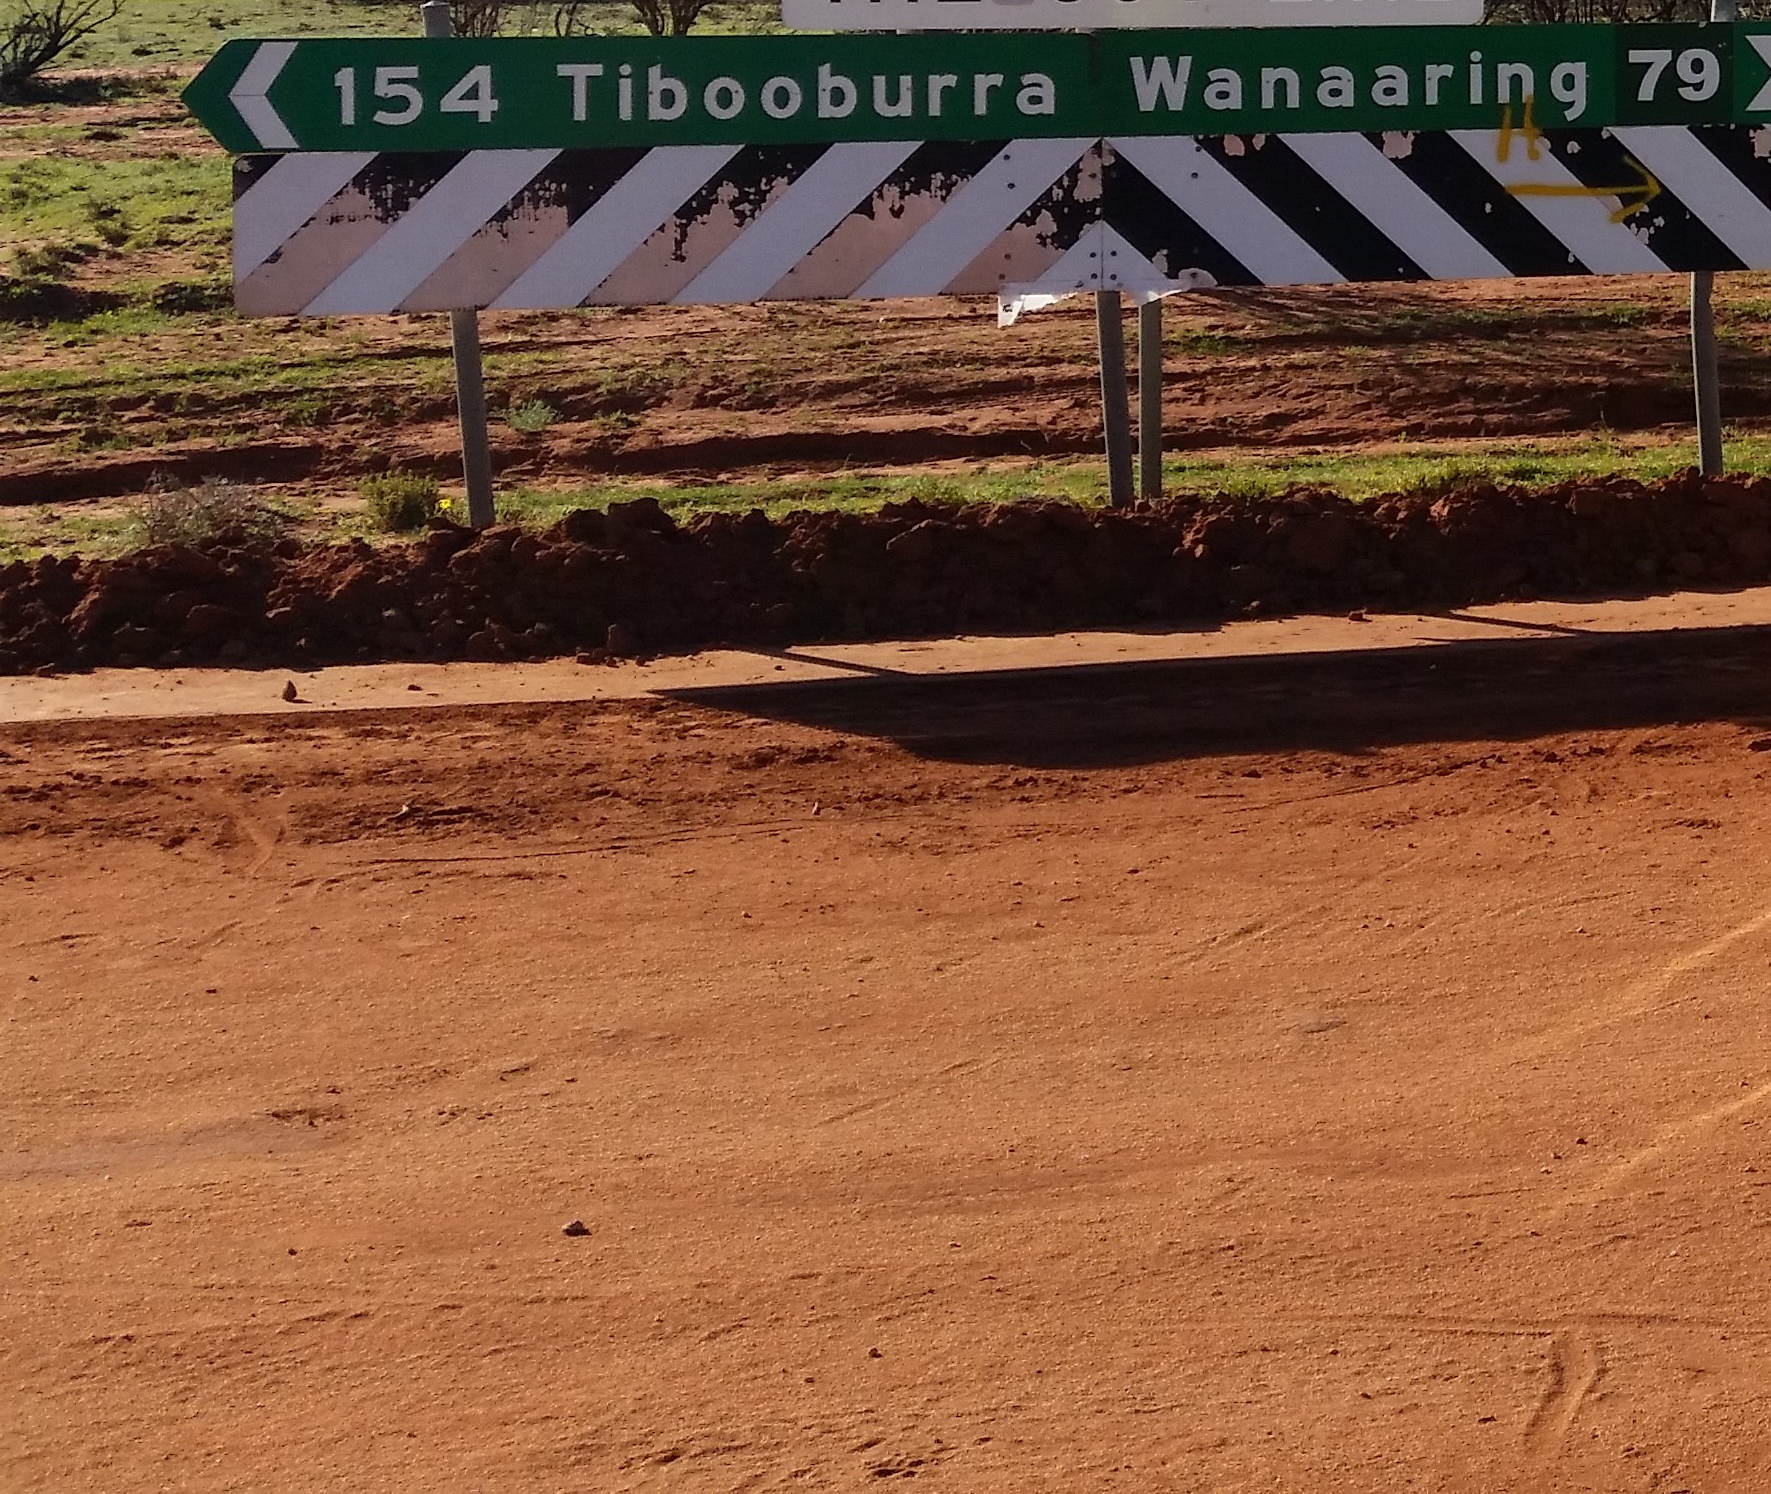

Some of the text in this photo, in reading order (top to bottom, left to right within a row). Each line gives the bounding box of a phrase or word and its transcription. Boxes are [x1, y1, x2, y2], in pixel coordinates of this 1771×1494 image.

[333, 48, 1722, 126] 154 Tibooburra Wanaaring 79
